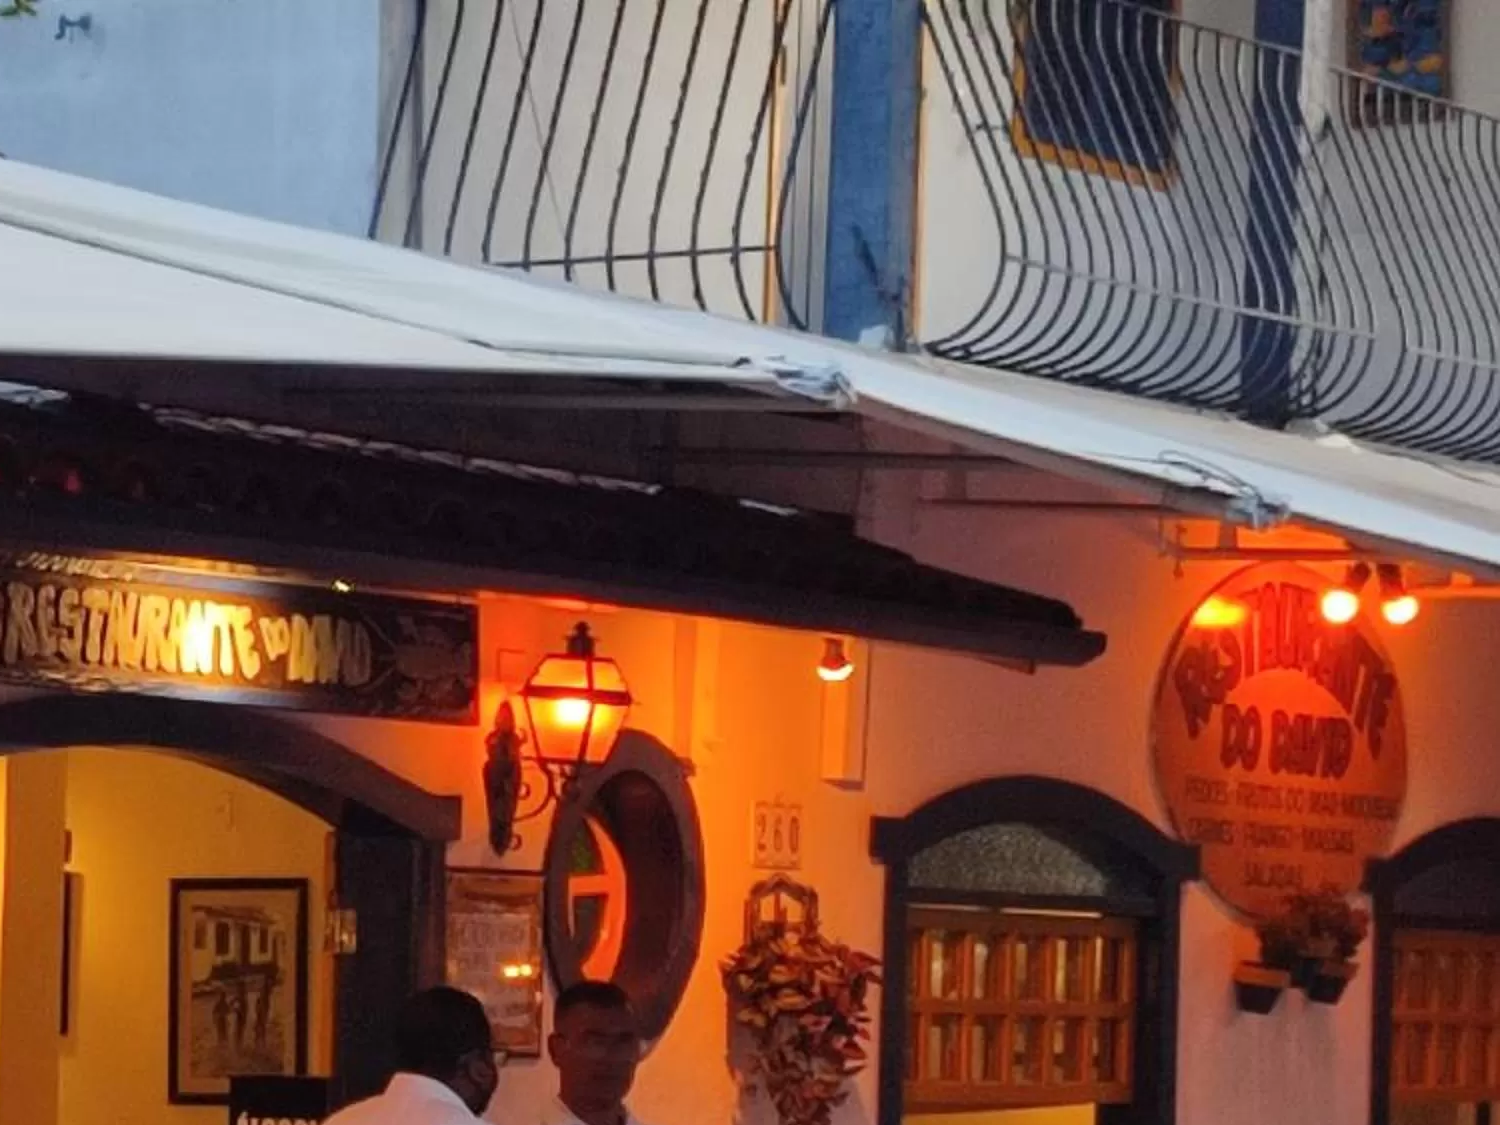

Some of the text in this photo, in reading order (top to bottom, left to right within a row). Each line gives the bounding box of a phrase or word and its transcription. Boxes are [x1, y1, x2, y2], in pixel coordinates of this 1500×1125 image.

[3, 580, 262, 680] RESTAURANTE
[1219, 703, 1263, 772] DO
[756, 814, 800, 856] 260
